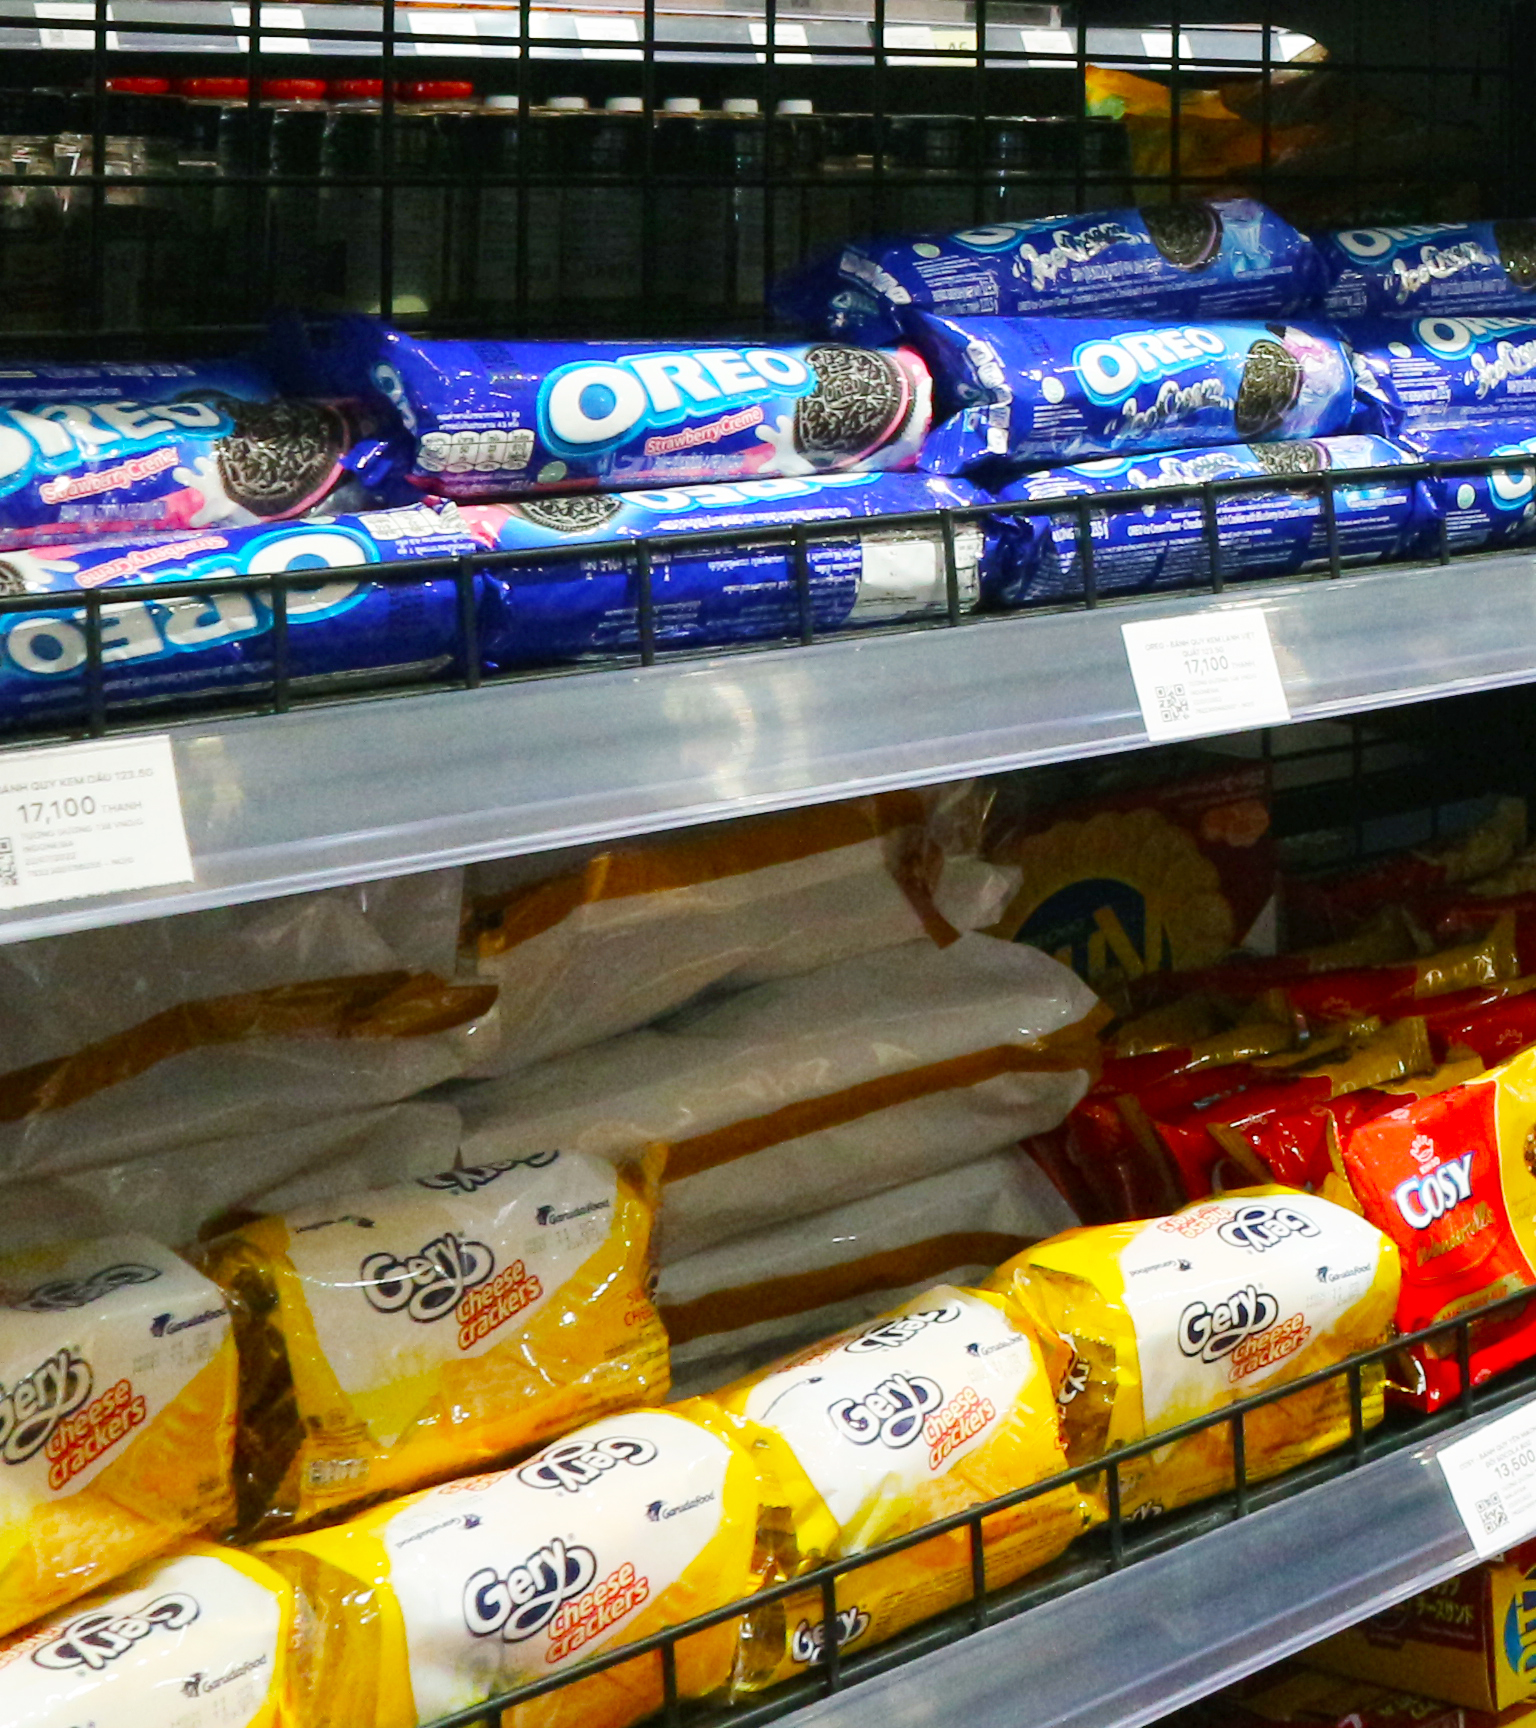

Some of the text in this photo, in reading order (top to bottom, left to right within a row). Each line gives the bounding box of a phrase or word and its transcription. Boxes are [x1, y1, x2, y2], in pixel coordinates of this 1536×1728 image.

[547, 348, 806, 443] OREO
[1080, 326, 1226, 395] OREO
[646, 406, 765, 456] Strawberry Creme
[40, 458, 127, 504] Strawberry
[130, 535, 228, 571] Strawberry
[1183, 655, 1229, 676] 17,100
[18, 795, 96, 825] 17,100
[1395, 1150, 1476, 1230] COSY
[360, 1231, 495, 1324] Gery
[455, 1259, 527, 1325] cheese
[458, 1278, 545, 1350] crackers
[1178, 1285, 1279, 1364] Gery
[1231, 1312, 1305, 1364] cheese
[1229, 1326, 1311, 1384] crackers
[45, 1379, 131, 1459] cheese
[49, 1395, 147, 1491] crackers
[825, 1373, 945, 1449] Gery
[922, 1385, 978, 1444] cheese
[928, 1398, 997, 1471] crackers
[517, 1434, 659, 1493] Gery
[1494, 1449, 1536, 1480] 13,500
[462, 1536, 597, 1644] Gery
[546, 1578, 650, 1665] crackers
[548, 1562, 635, 1639] cheese
[31, 1591, 201, 1671] Gery
